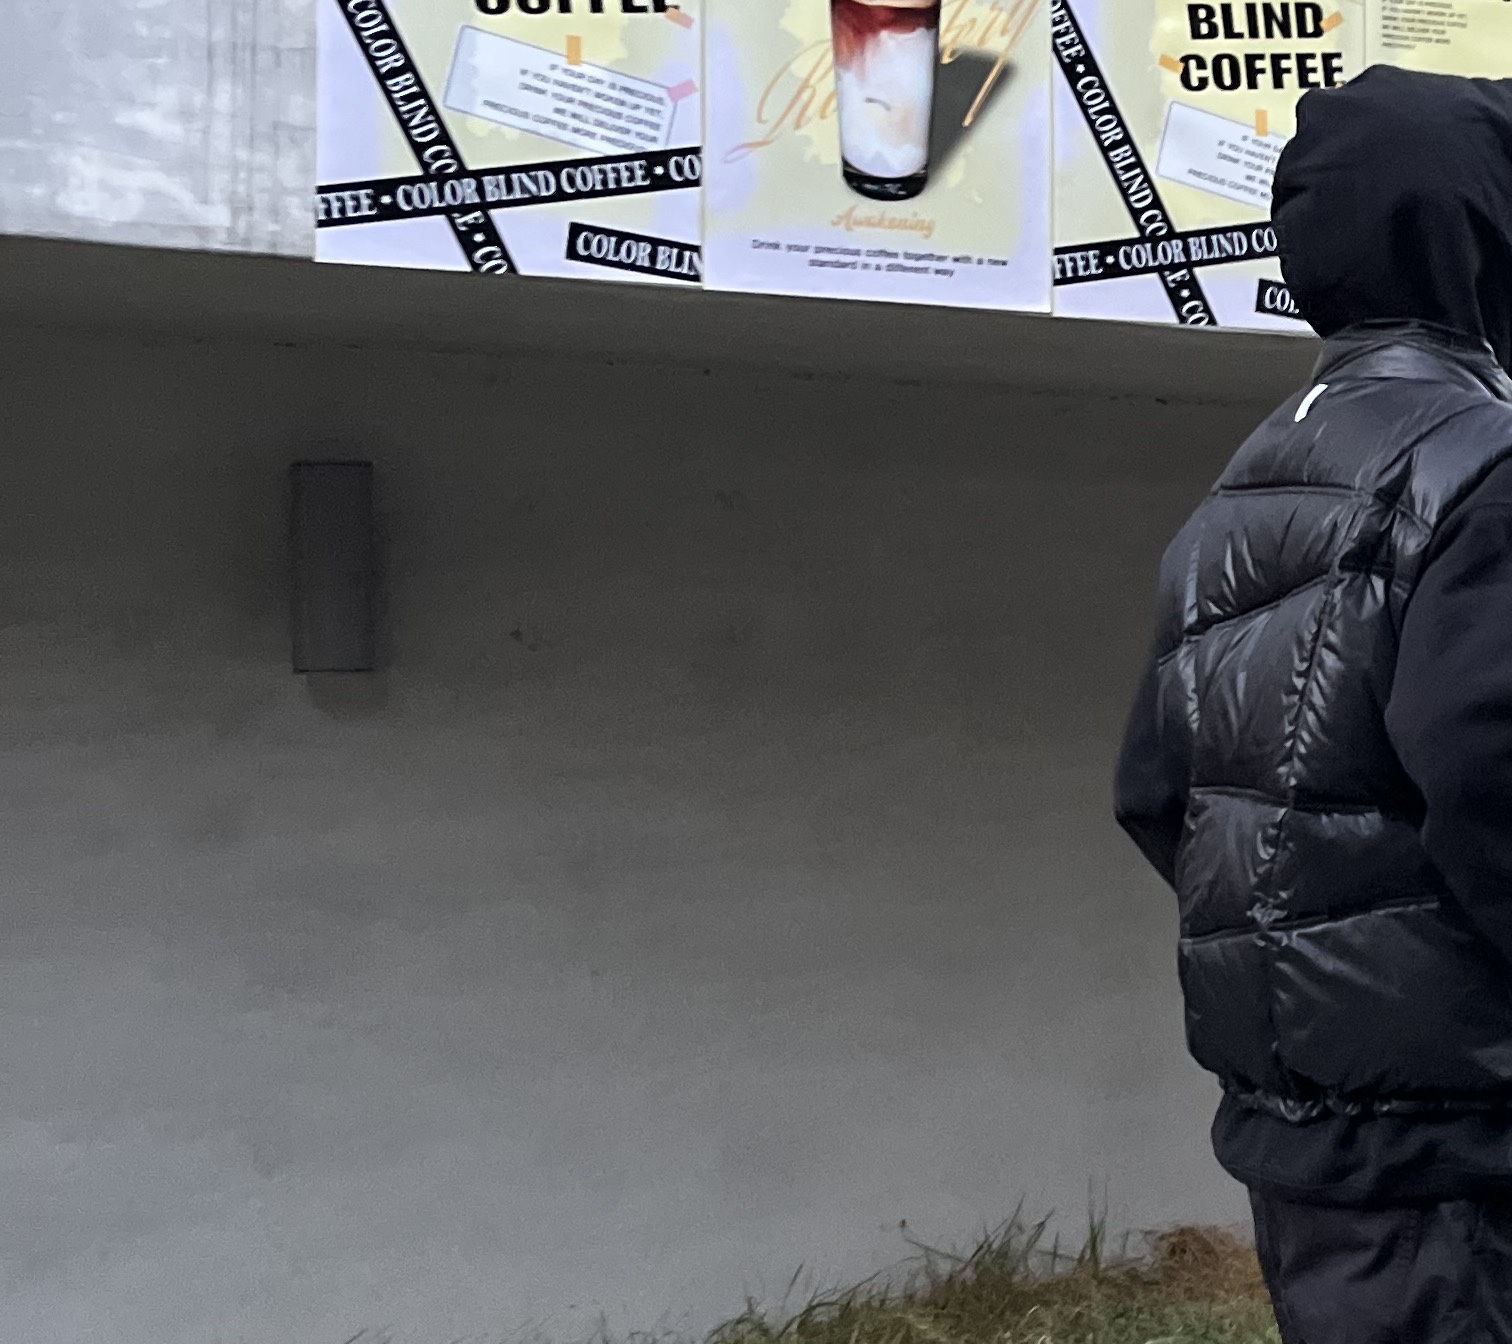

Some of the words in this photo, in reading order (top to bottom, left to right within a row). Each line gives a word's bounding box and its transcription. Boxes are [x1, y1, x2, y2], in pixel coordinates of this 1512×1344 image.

[1187, 1, 1324, 40] BLIND
[1178, 51, 1345, 92] COFFEE
[385, 71, 439, 143] BLIND
[1075, 75, 1124, 146] COLOR
[1108, 144, 1153, 208] BLIND
[396, 177, 481, 211] COLOR
[480, 169, 557, 202] BLIND
[559, 159, 651, 193] COFFEE
[575, 231, 652, 267] COLOR
[1117, 238, 1187, 270] COLOR
[1186, 231, 1248, 261] BLIND
